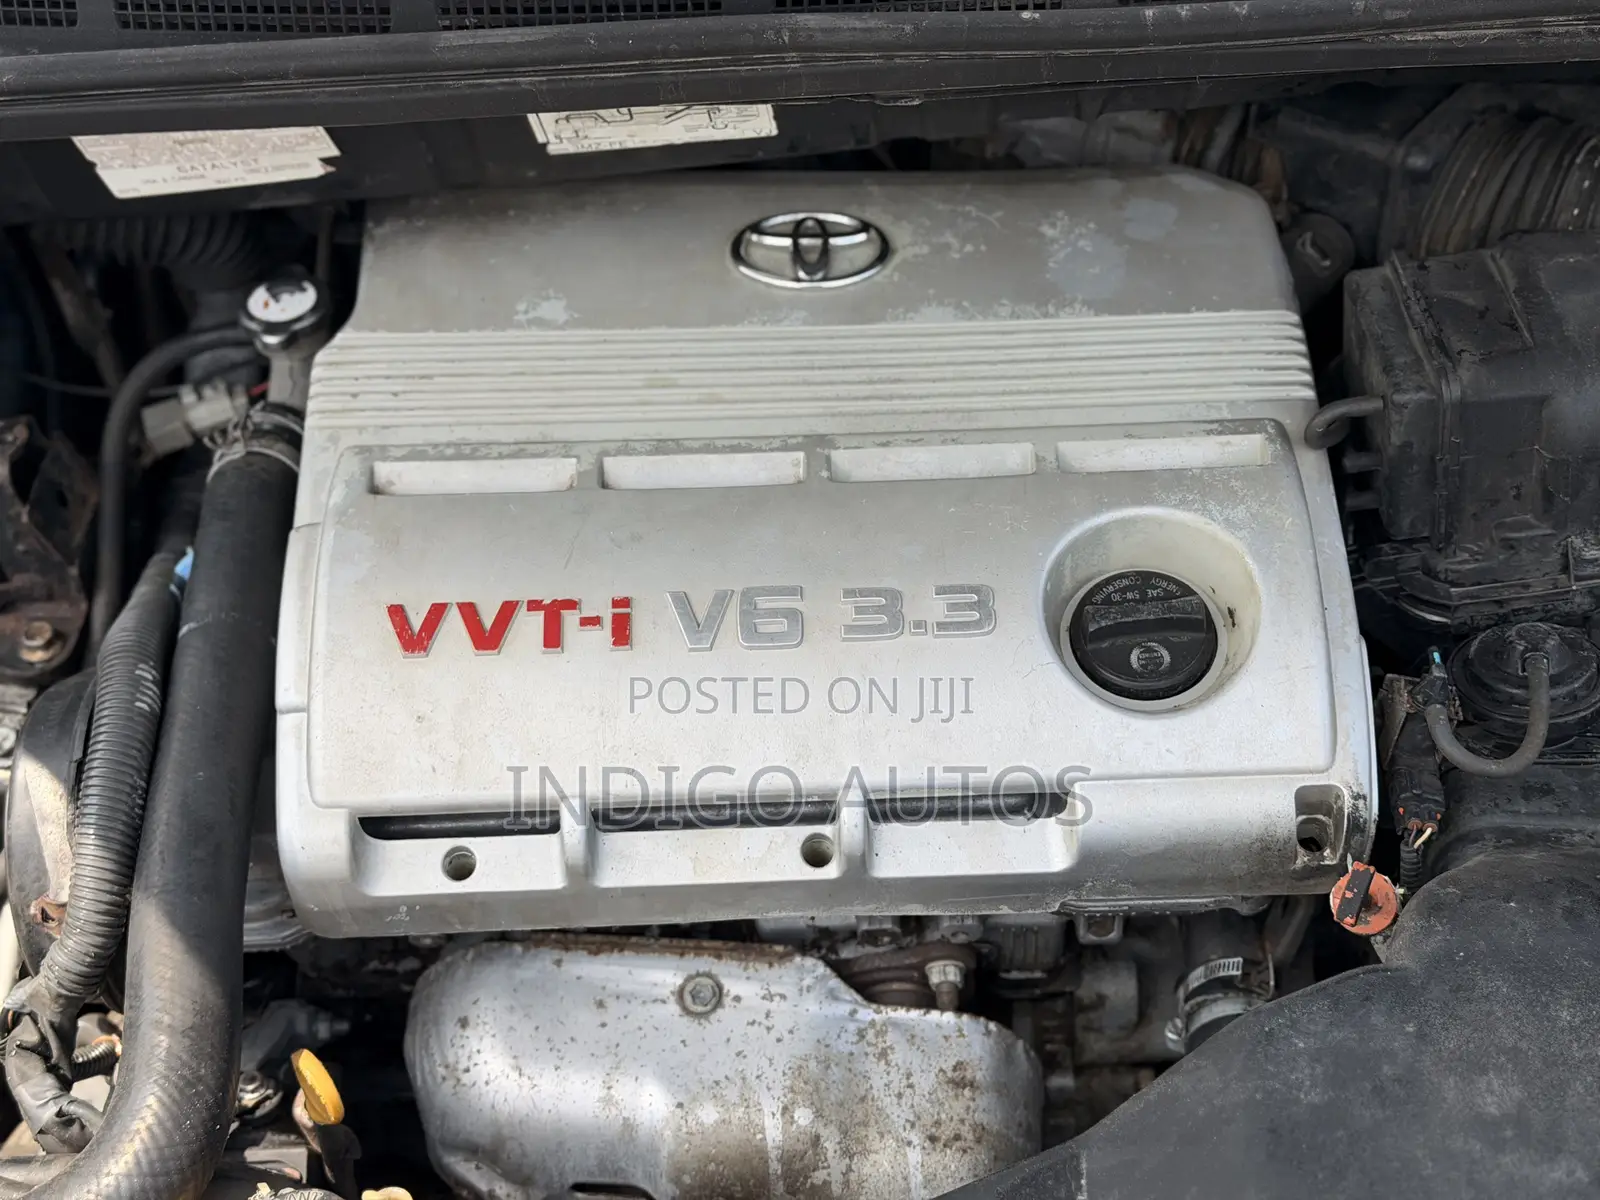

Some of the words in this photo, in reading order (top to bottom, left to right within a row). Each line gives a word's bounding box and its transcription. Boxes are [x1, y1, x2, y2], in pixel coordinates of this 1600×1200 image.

[1091, 575, 1142, 604] CONSERVING
[1111, 591, 1140, 602] 5W-30
[1146, 588, 1165, 599] SAE
[386, 596, 633, 659] VVT-i
[666, 586, 804, 653] V6
[839, 583, 997, 643] 3.3
